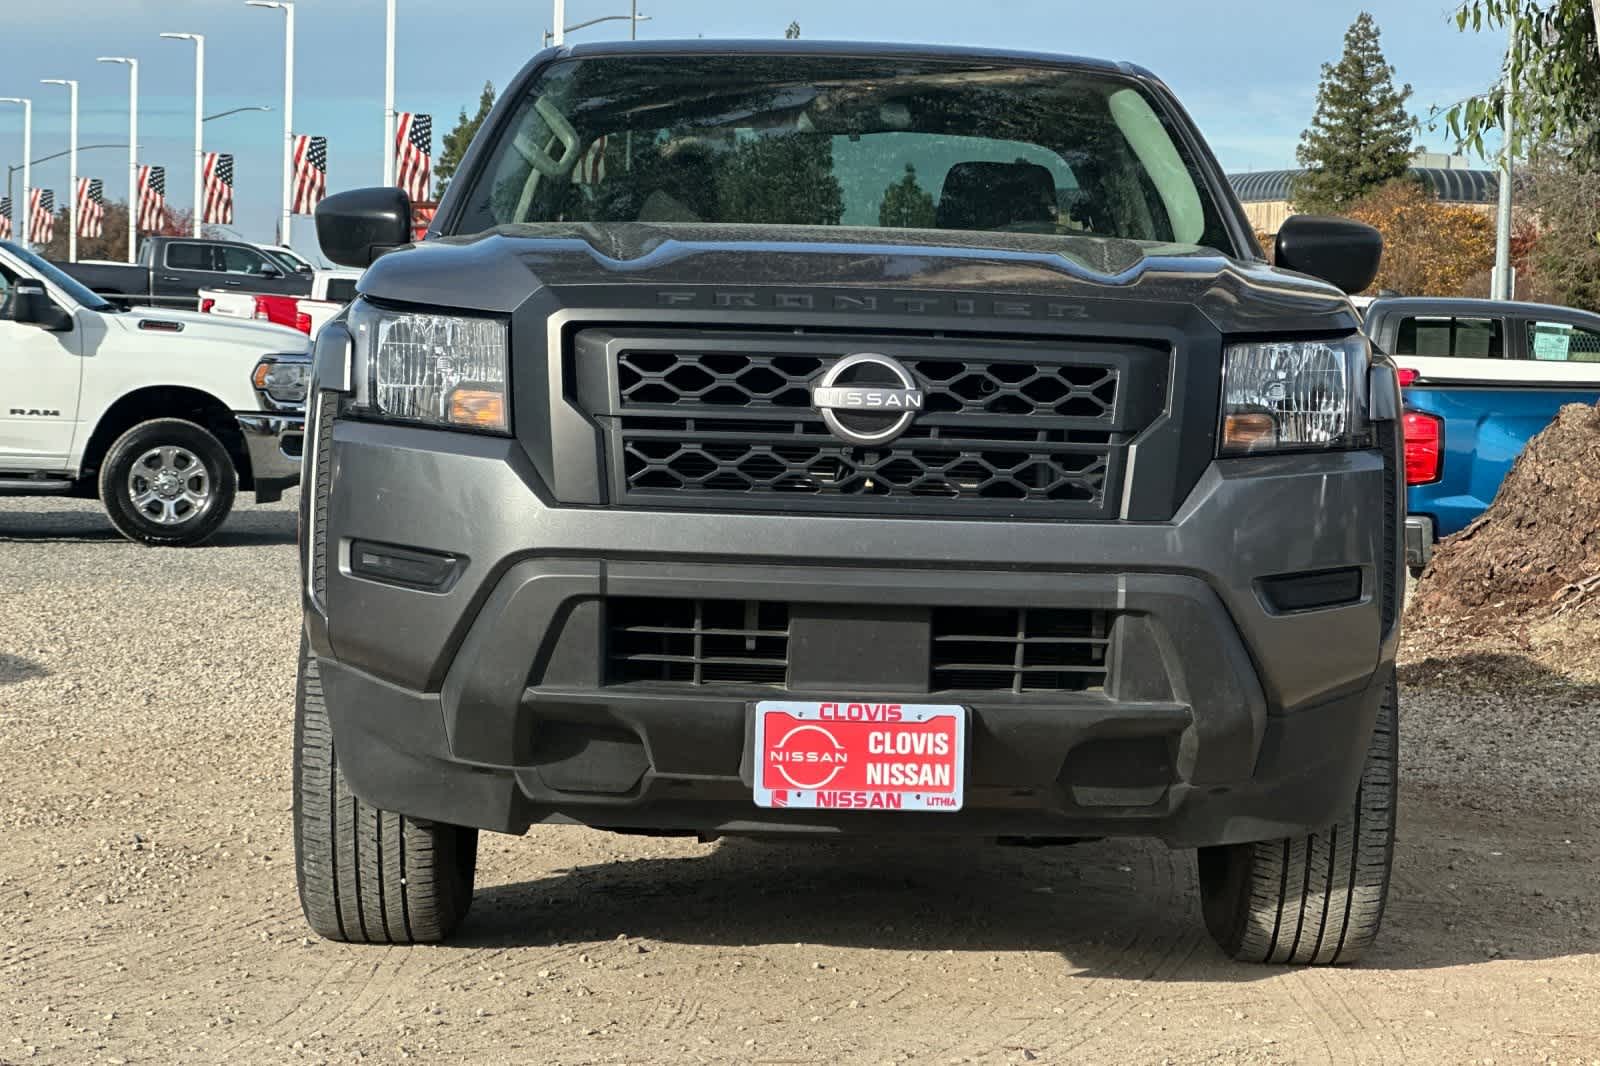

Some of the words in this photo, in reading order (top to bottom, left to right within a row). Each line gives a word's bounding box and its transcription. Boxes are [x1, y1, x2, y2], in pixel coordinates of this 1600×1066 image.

[655, 291, 1089, 318] FRONTIER
[9, 408, 60, 416] RAM
[819, 703, 902, 721] CLOVIS
[868, 731, 949, 755] CLOVIS
[770, 751, 848, 763] NISSAN
[866, 763, 950, 786] NISSAN
[816, 791, 902, 809] NISSAN
[926, 796, 957, 807] LITHIA
